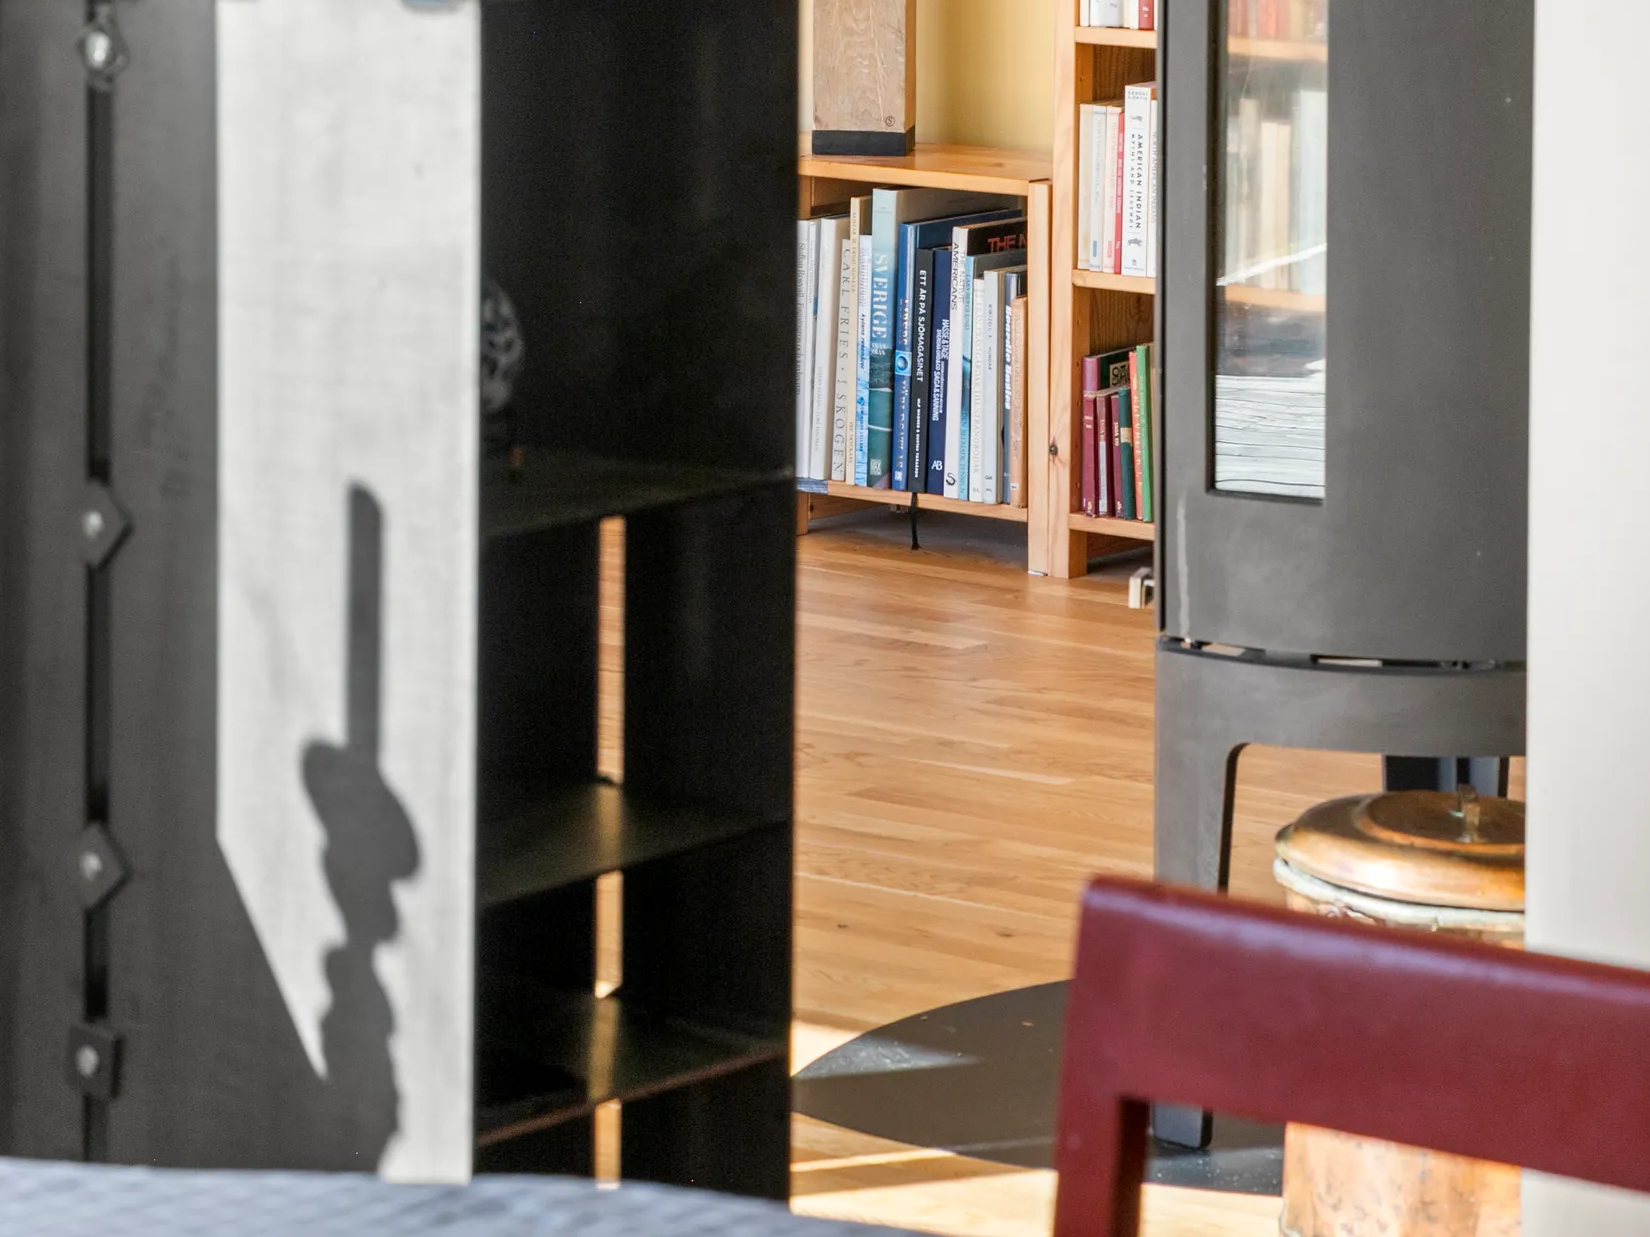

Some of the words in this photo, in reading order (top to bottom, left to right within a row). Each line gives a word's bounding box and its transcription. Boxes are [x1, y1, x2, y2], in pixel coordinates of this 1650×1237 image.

[987, 234, 1017, 253] THE
[842, 248, 851, 297] CARL
[872, 253, 888, 339] SVERIGE
[919, 269, 927, 286] ETT
[919, 287, 927, 301] ÅR
[951, 241, 959, 311] AMERICANS
[957, 270, 965, 304] NATIVE
[840, 306, 850, 360] FRIES
[918, 302, 926, 315] PÅ
[916, 316, 926, 383] SJÖMAGASINET
[833, 393, 847, 473] SKOGEN
